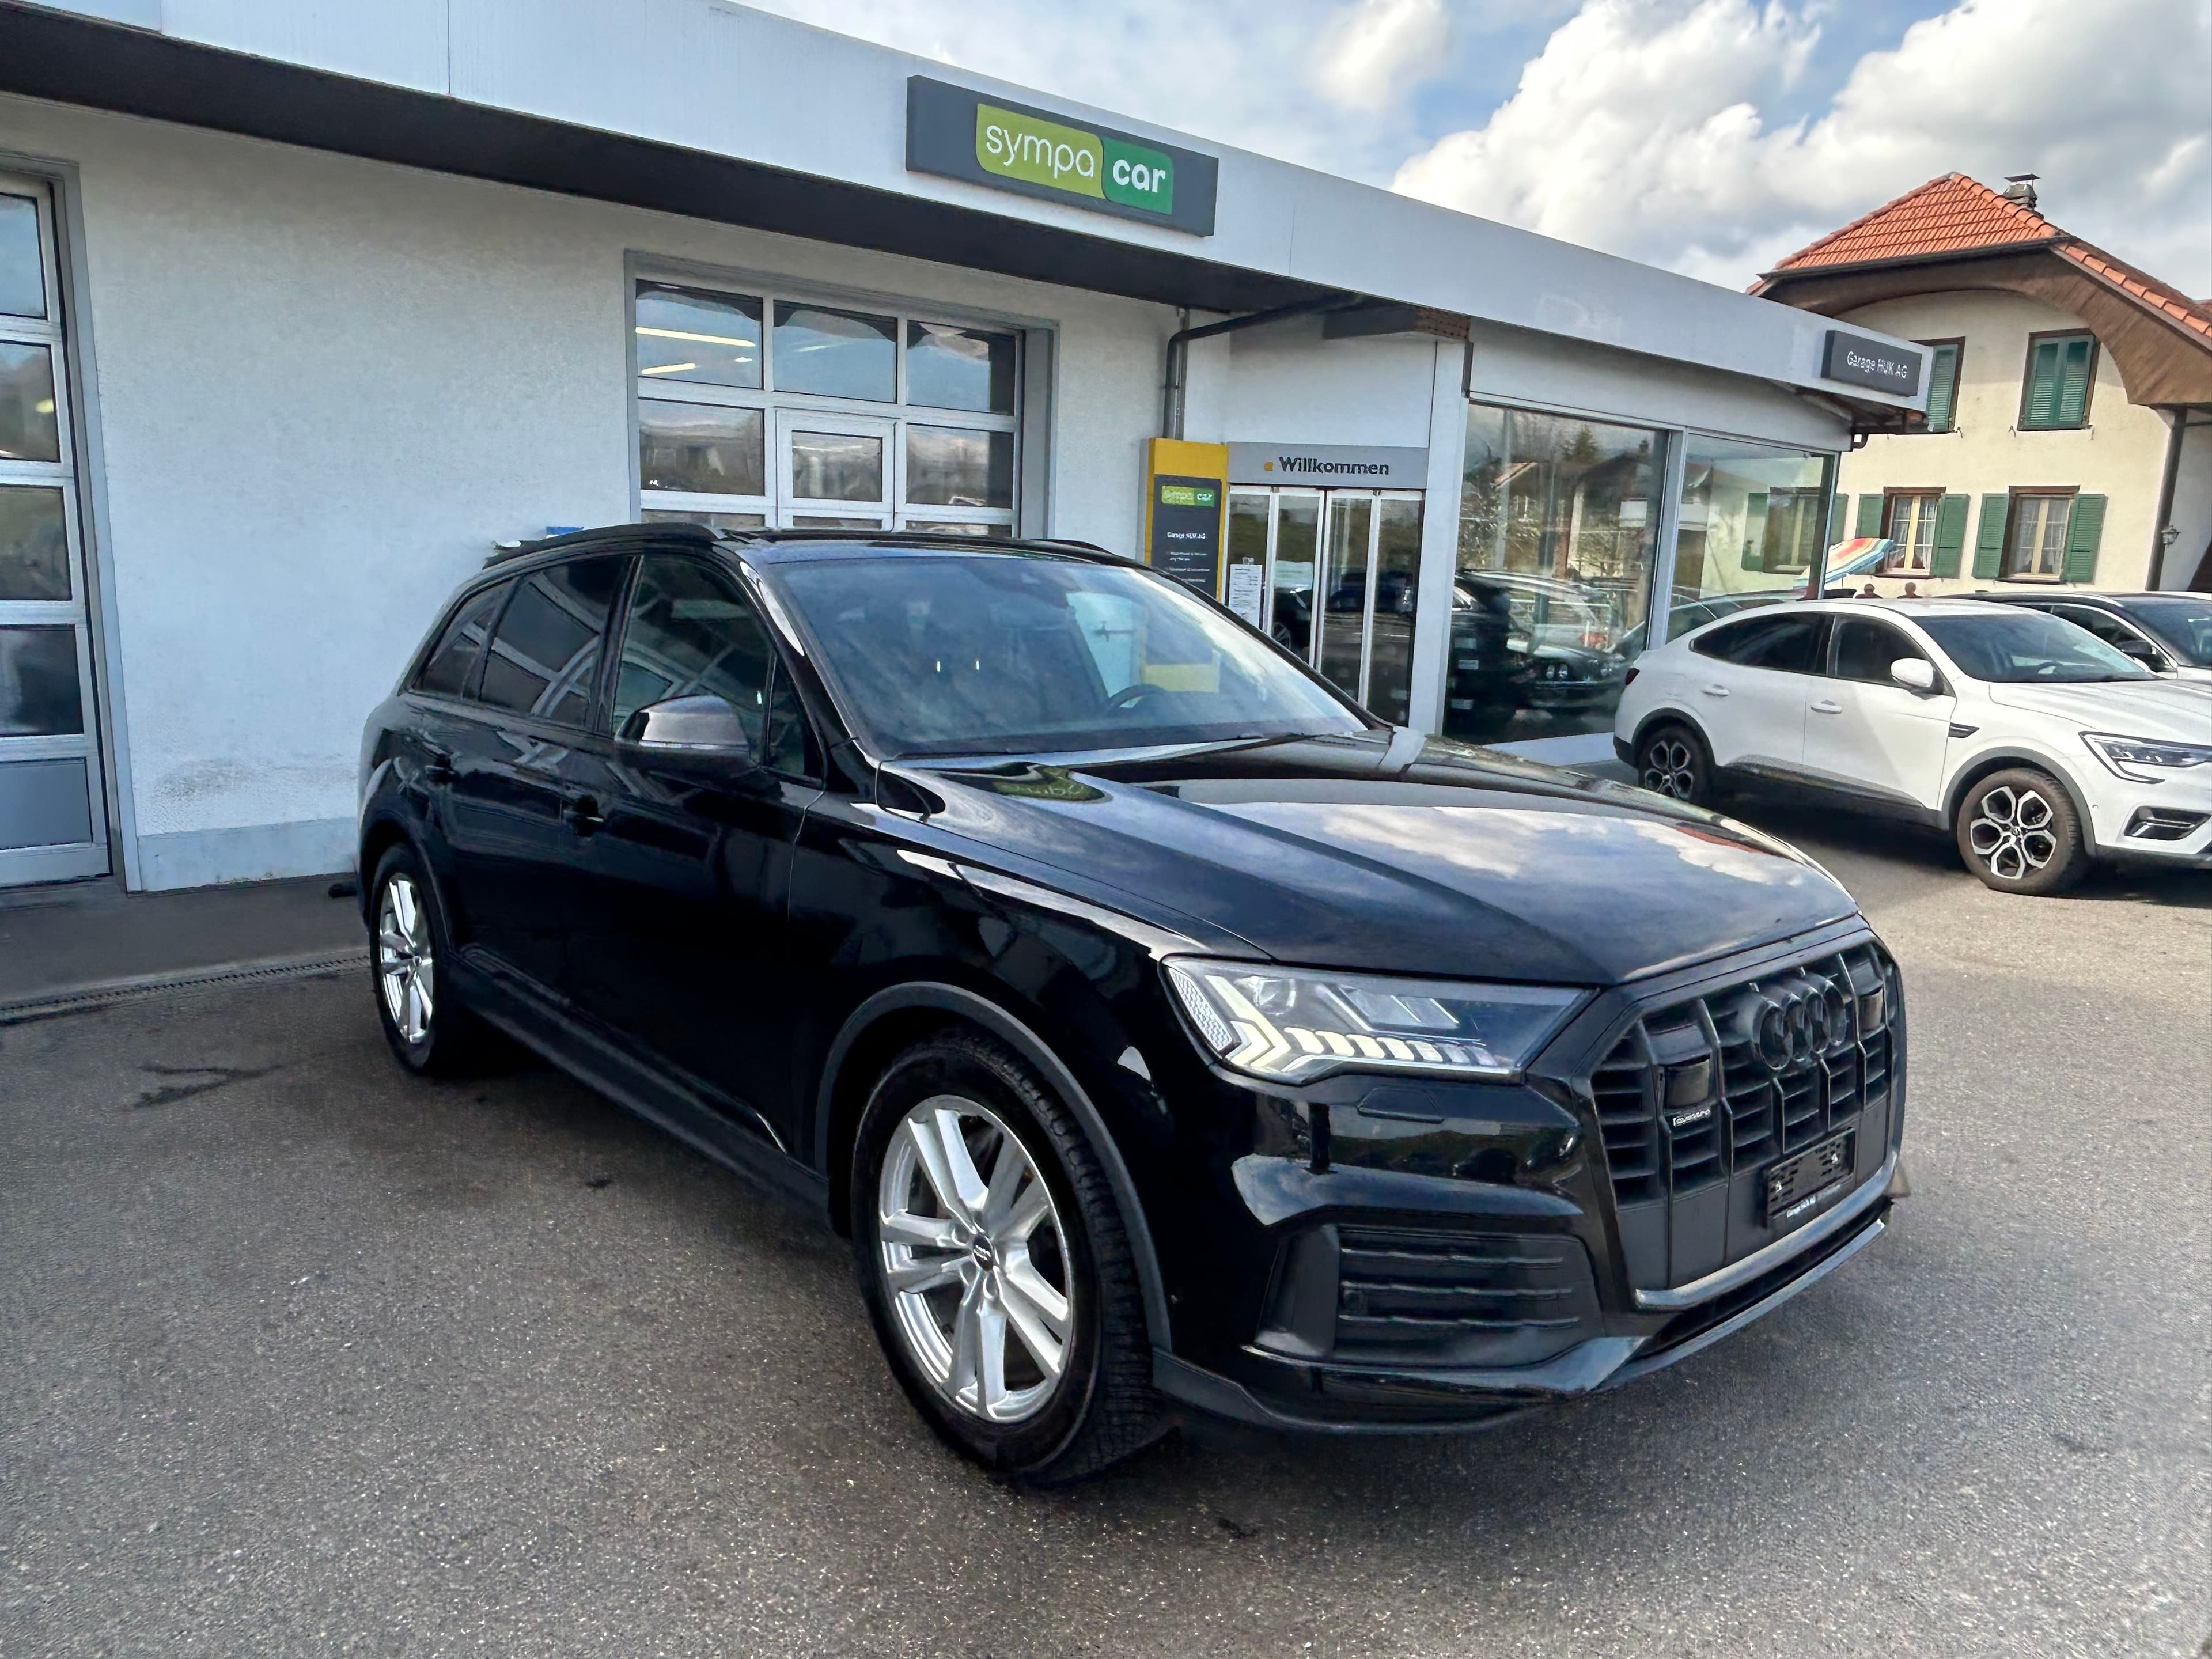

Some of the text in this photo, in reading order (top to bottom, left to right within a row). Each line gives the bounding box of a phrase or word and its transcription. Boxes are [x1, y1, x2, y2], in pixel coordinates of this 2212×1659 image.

[986, 125, 1166, 193] sympa car
[1847, 351, 1875, 373] Garage
[1895, 364, 1908, 378] AG
[1279, 456, 1389, 475] Willkommen
